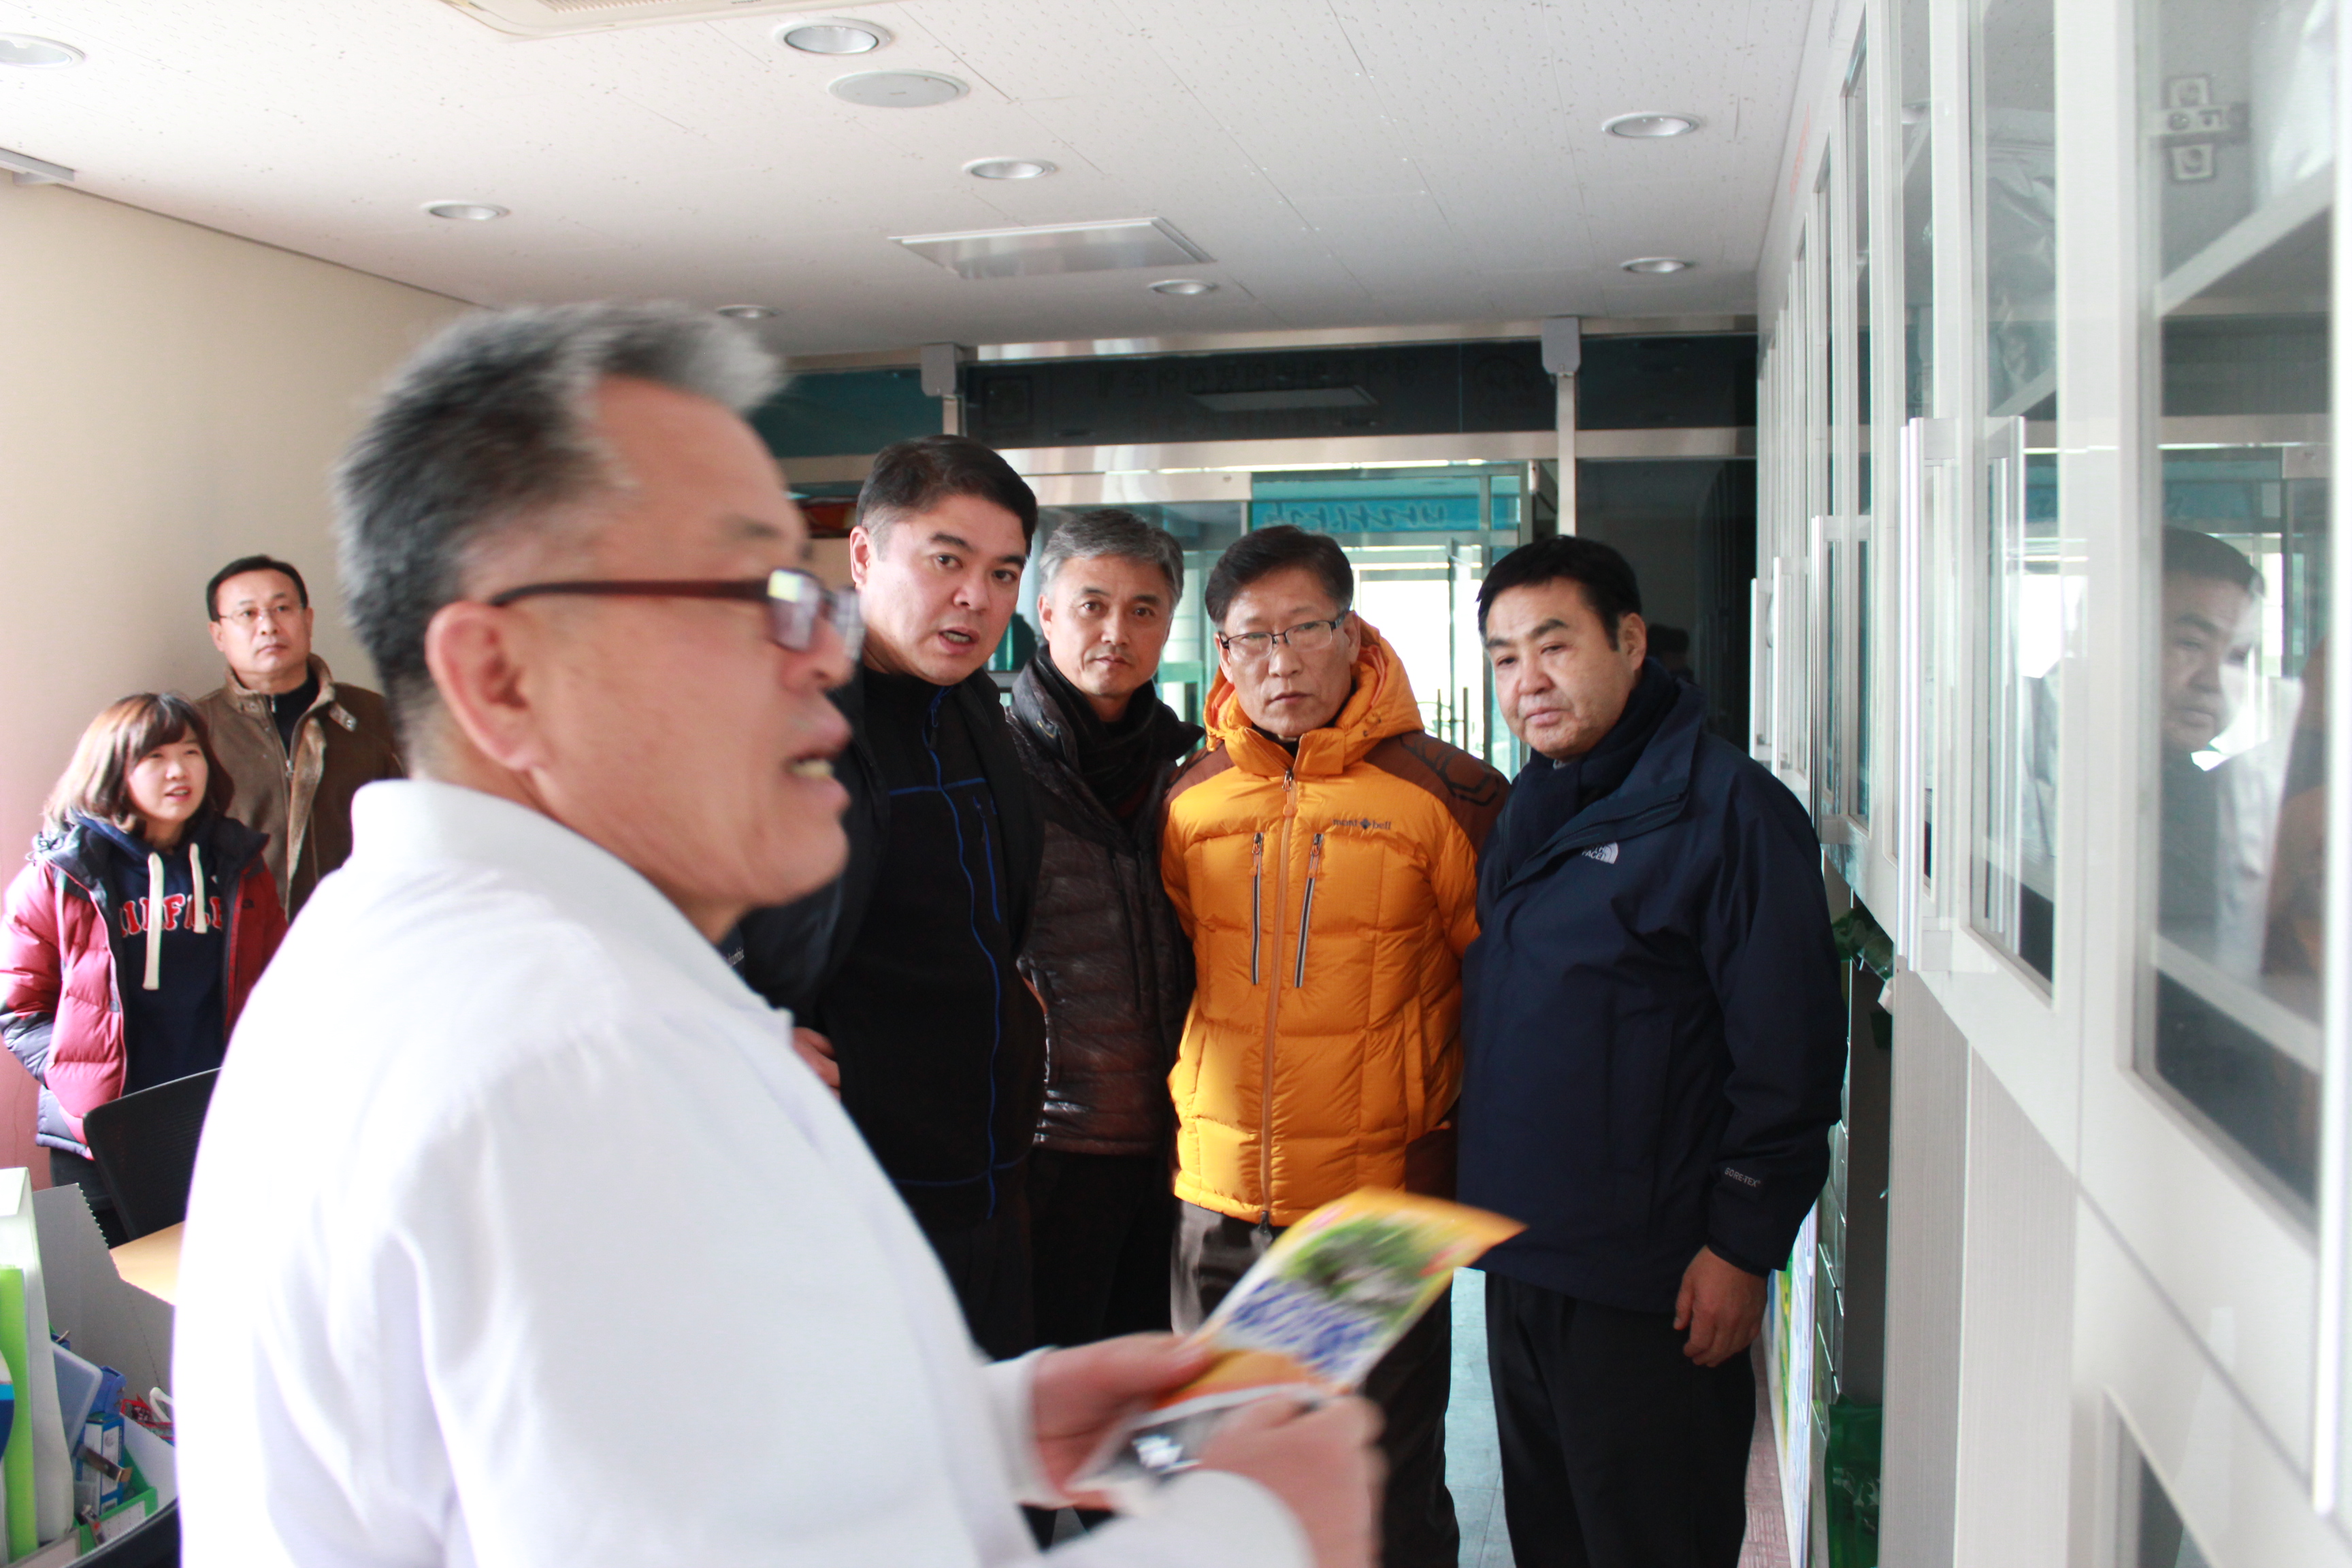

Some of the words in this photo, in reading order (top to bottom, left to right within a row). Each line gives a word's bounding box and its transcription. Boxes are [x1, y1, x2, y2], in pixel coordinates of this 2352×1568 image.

[1332, 819, 1358, 827] mont
[1372, 820, 1392, 830] bell
[1724, 1167, 1759, 1188] GORE-TEX
